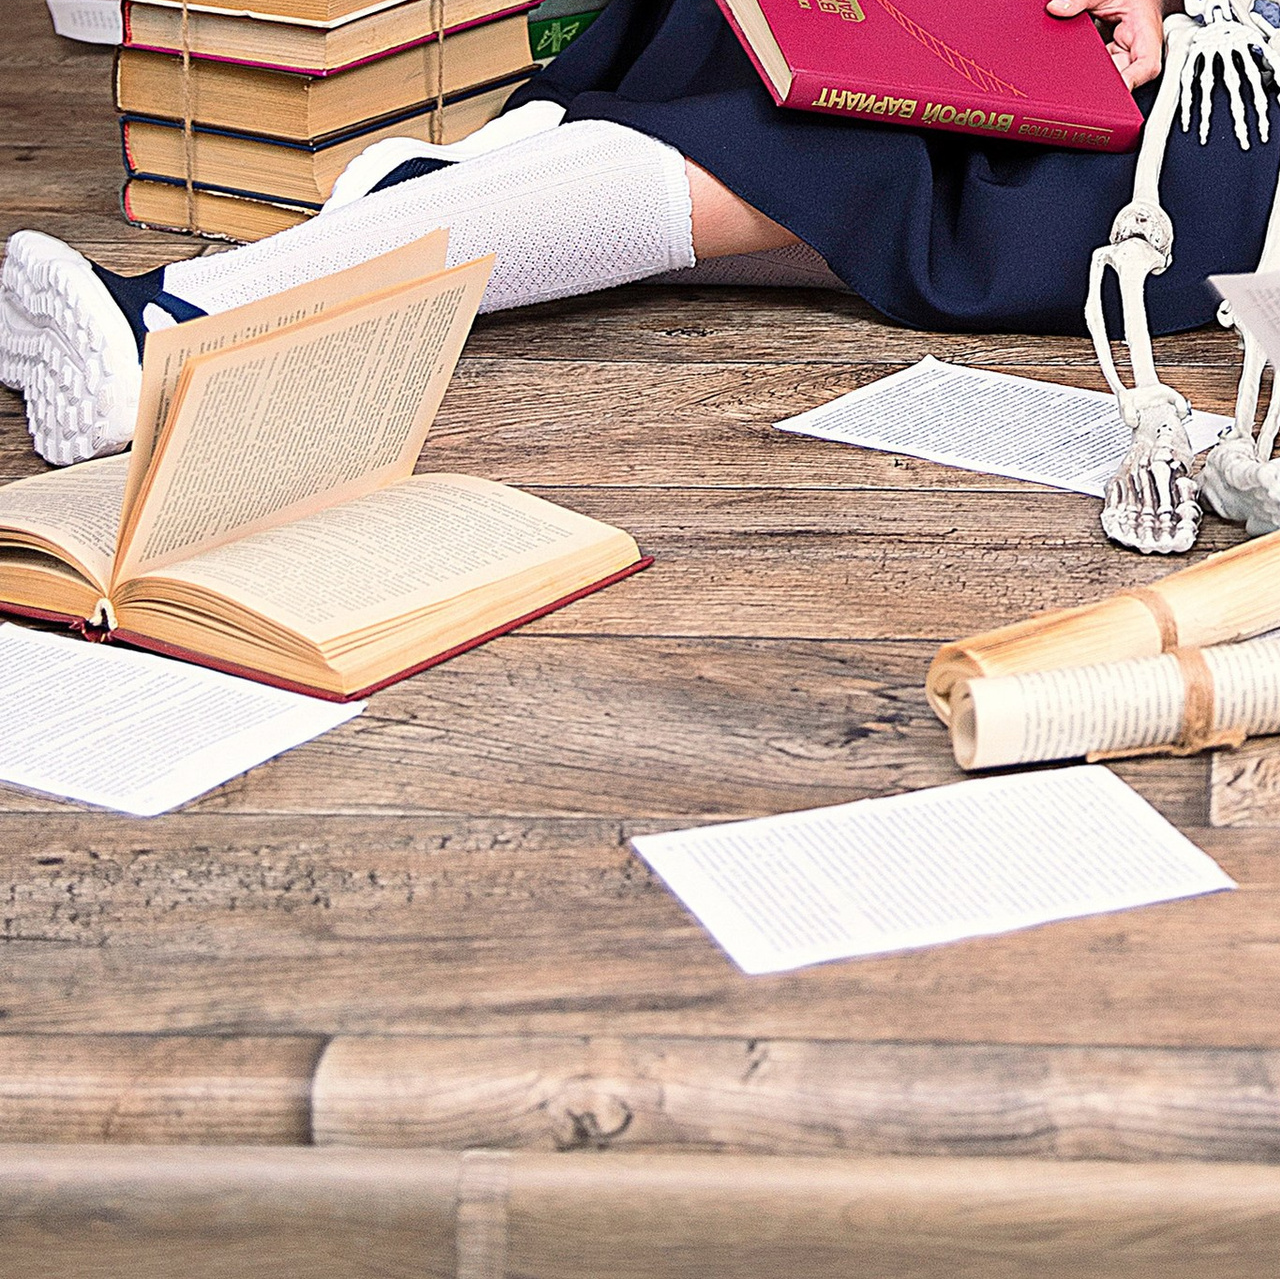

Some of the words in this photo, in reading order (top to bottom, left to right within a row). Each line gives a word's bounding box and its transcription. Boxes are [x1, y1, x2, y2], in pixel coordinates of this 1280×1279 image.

[811, 87, 918, 119] ВАРИАНТ
[921, 102, 1015, 133] ВТОРОЙ
[1018, 123, 1067, 141] ТЕПЛОВ
